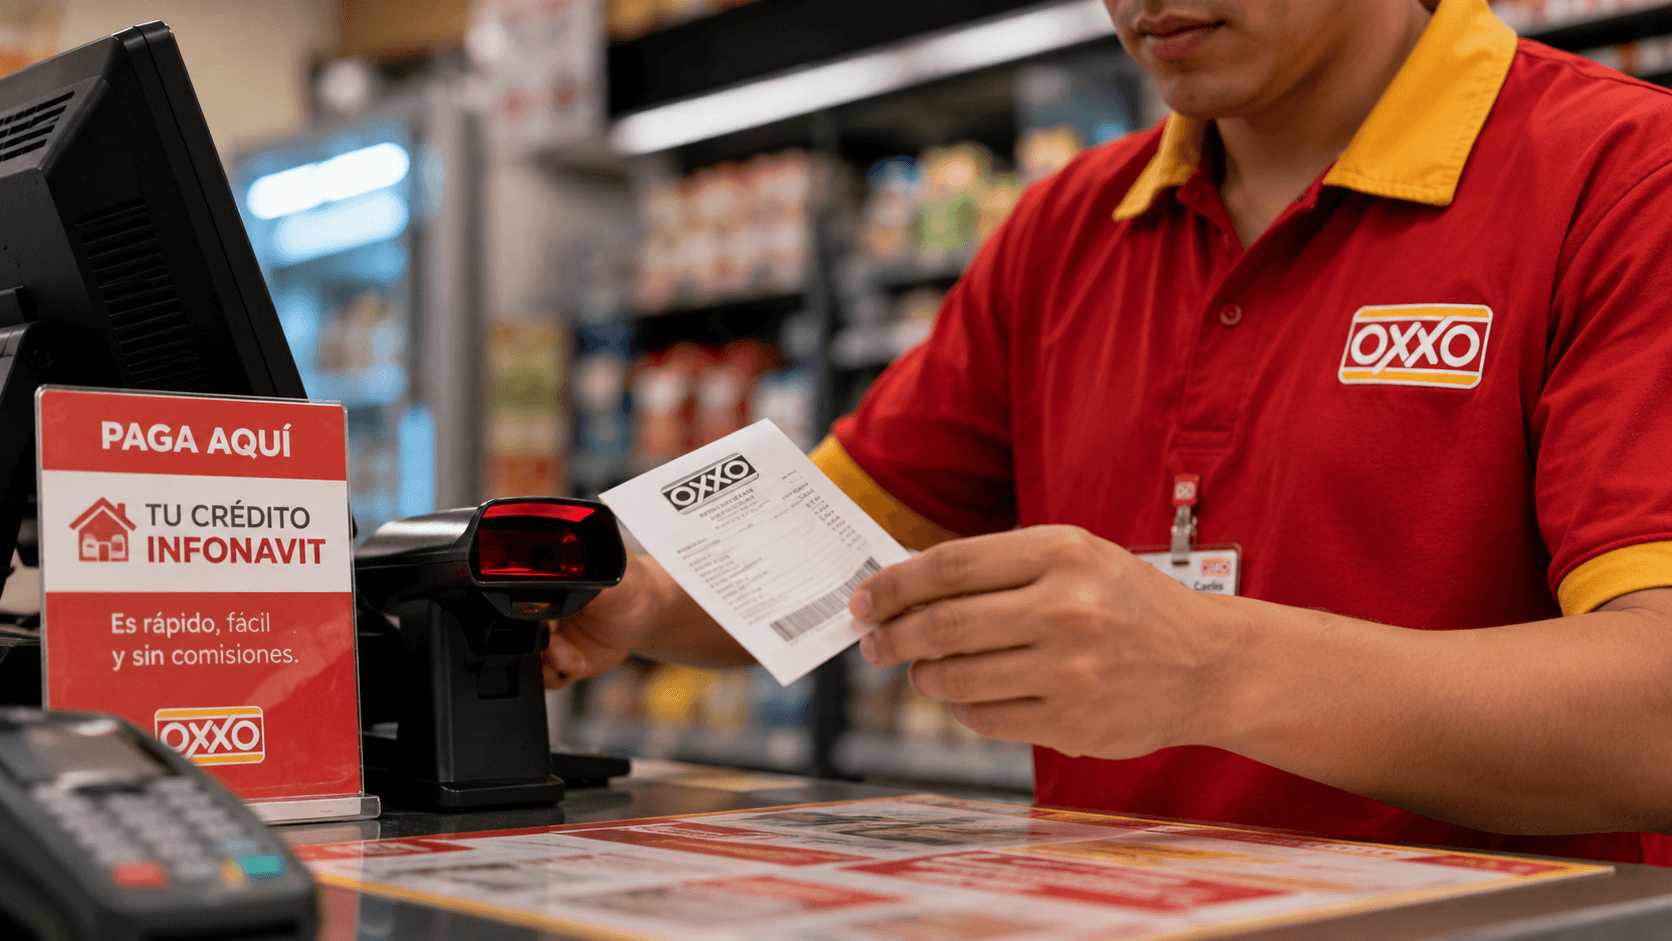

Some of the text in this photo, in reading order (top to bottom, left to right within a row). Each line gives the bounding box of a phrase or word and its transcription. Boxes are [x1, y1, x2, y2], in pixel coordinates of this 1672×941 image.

[1350, 316, 1481, 374] OXXO
[101, 420, 292, 459] PAGA AQUÍ
[669, 459, 750, 506] OXXO
[145, 500, 311, 529] TU CRÉDITO
[146, 535, 326, 565] INFONAVIT
[111, 611, 271, 638] Es rápido, fácil
[112, 643, 299, 671] y sin comisiones.
[160, 715, 260, 758] OXXO
